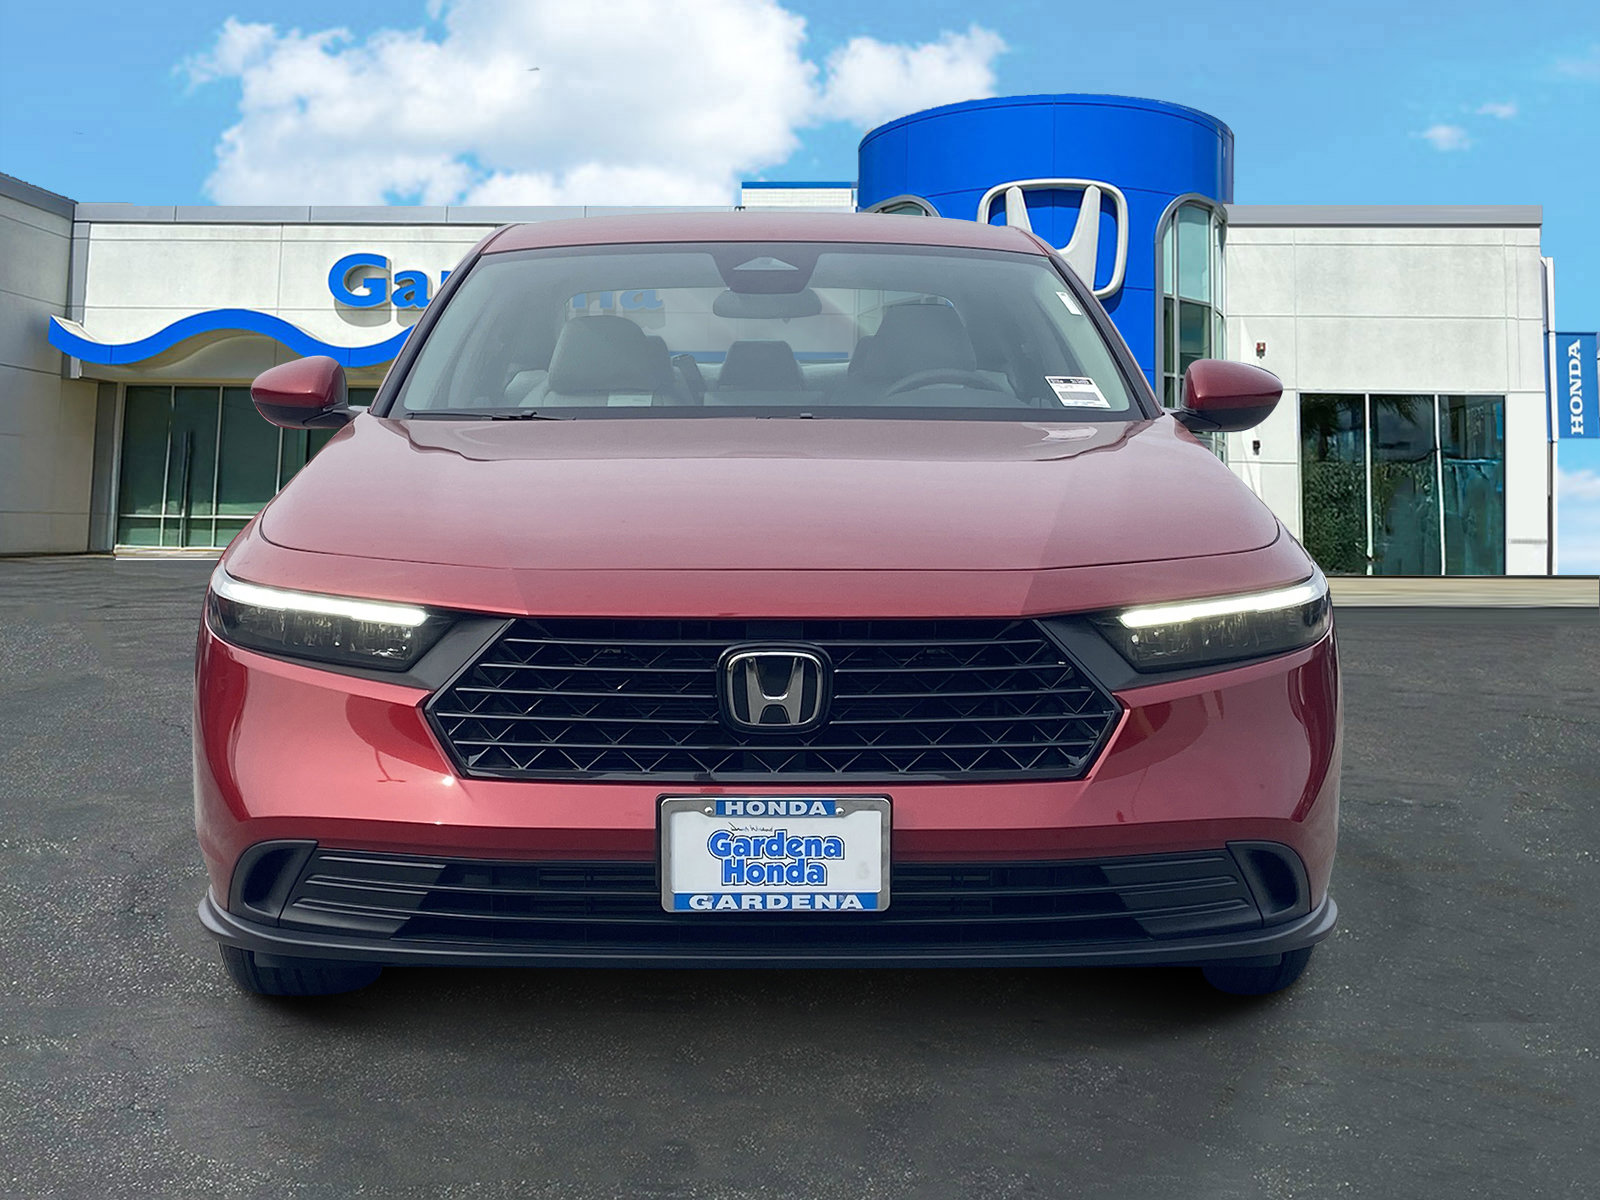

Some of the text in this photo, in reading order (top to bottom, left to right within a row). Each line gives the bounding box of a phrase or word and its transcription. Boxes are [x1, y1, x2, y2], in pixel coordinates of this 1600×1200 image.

[1568, 339, 1584, 435] HONDA
[725, 801, 828, 816] HONDA
[708, 830, 844, 860] Gardena
[722, 860, 827, 885] Honda
[688, 894, 864, 910] GARDENA
